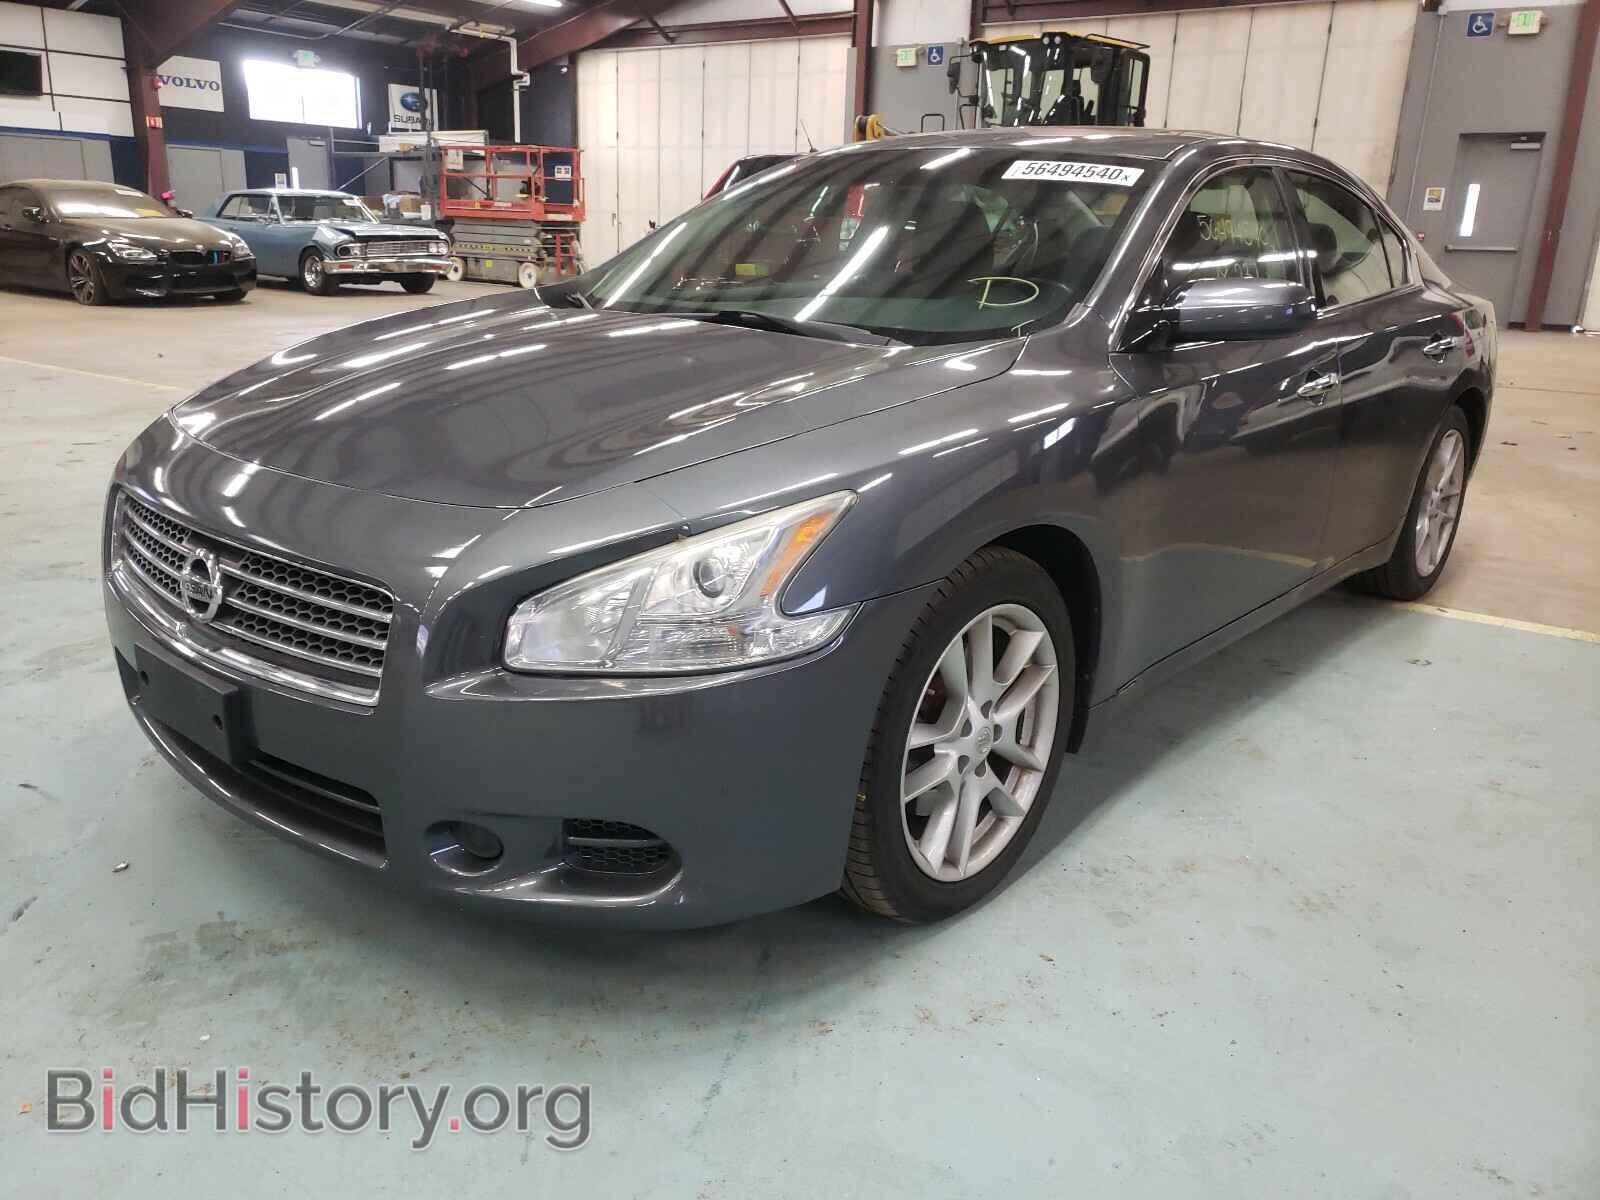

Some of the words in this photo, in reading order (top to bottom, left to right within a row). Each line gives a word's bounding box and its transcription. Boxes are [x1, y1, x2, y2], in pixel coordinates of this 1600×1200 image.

[159, 75, 220, 91] VOLVO
[393, 114, 433, 129] SUBAU
[1021, 162, 1123, 180] 56494540
